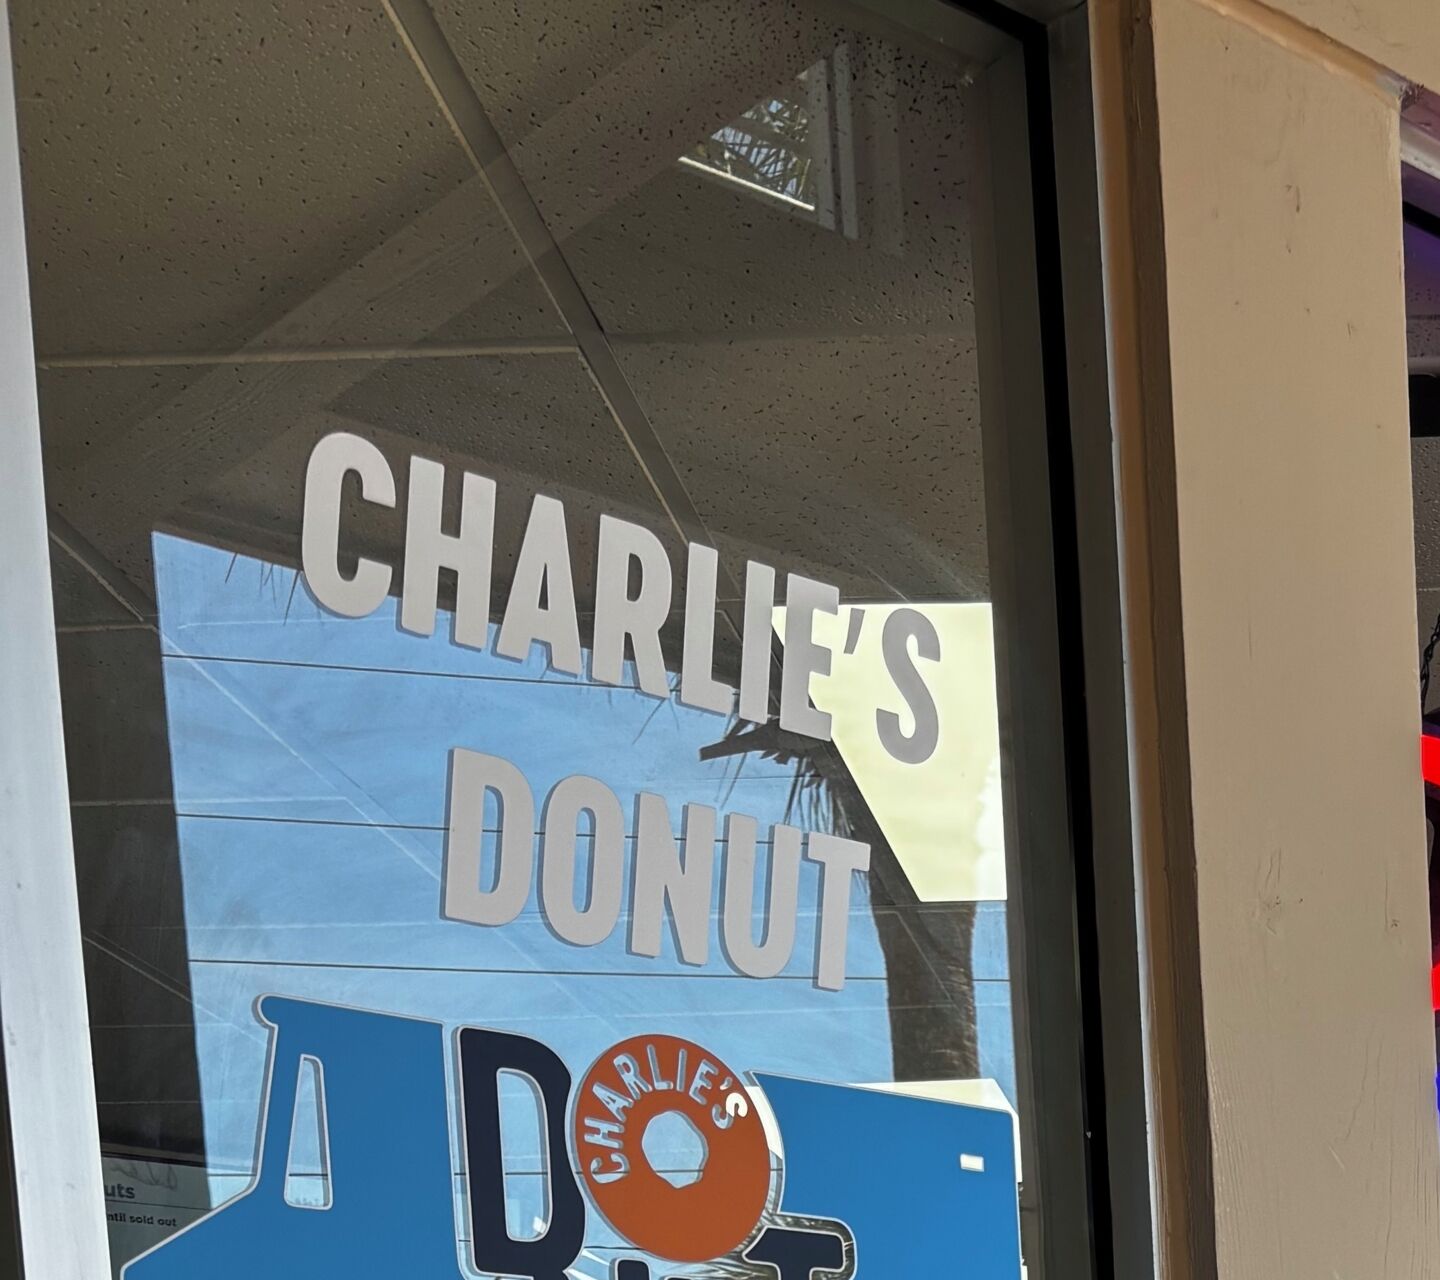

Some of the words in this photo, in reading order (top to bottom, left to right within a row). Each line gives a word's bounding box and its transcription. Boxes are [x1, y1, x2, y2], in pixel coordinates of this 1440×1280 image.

[301, 430, 942, 766] CHARLIE'S
[444, 746, 871, 993] DONUT
[583, 1042, 749, 1185] CHARLIE'S
[107, 1212, 126, 1223] ntil
[129, 1214, 154, 1225] sold
[157, 1217, 177, 1227] out
